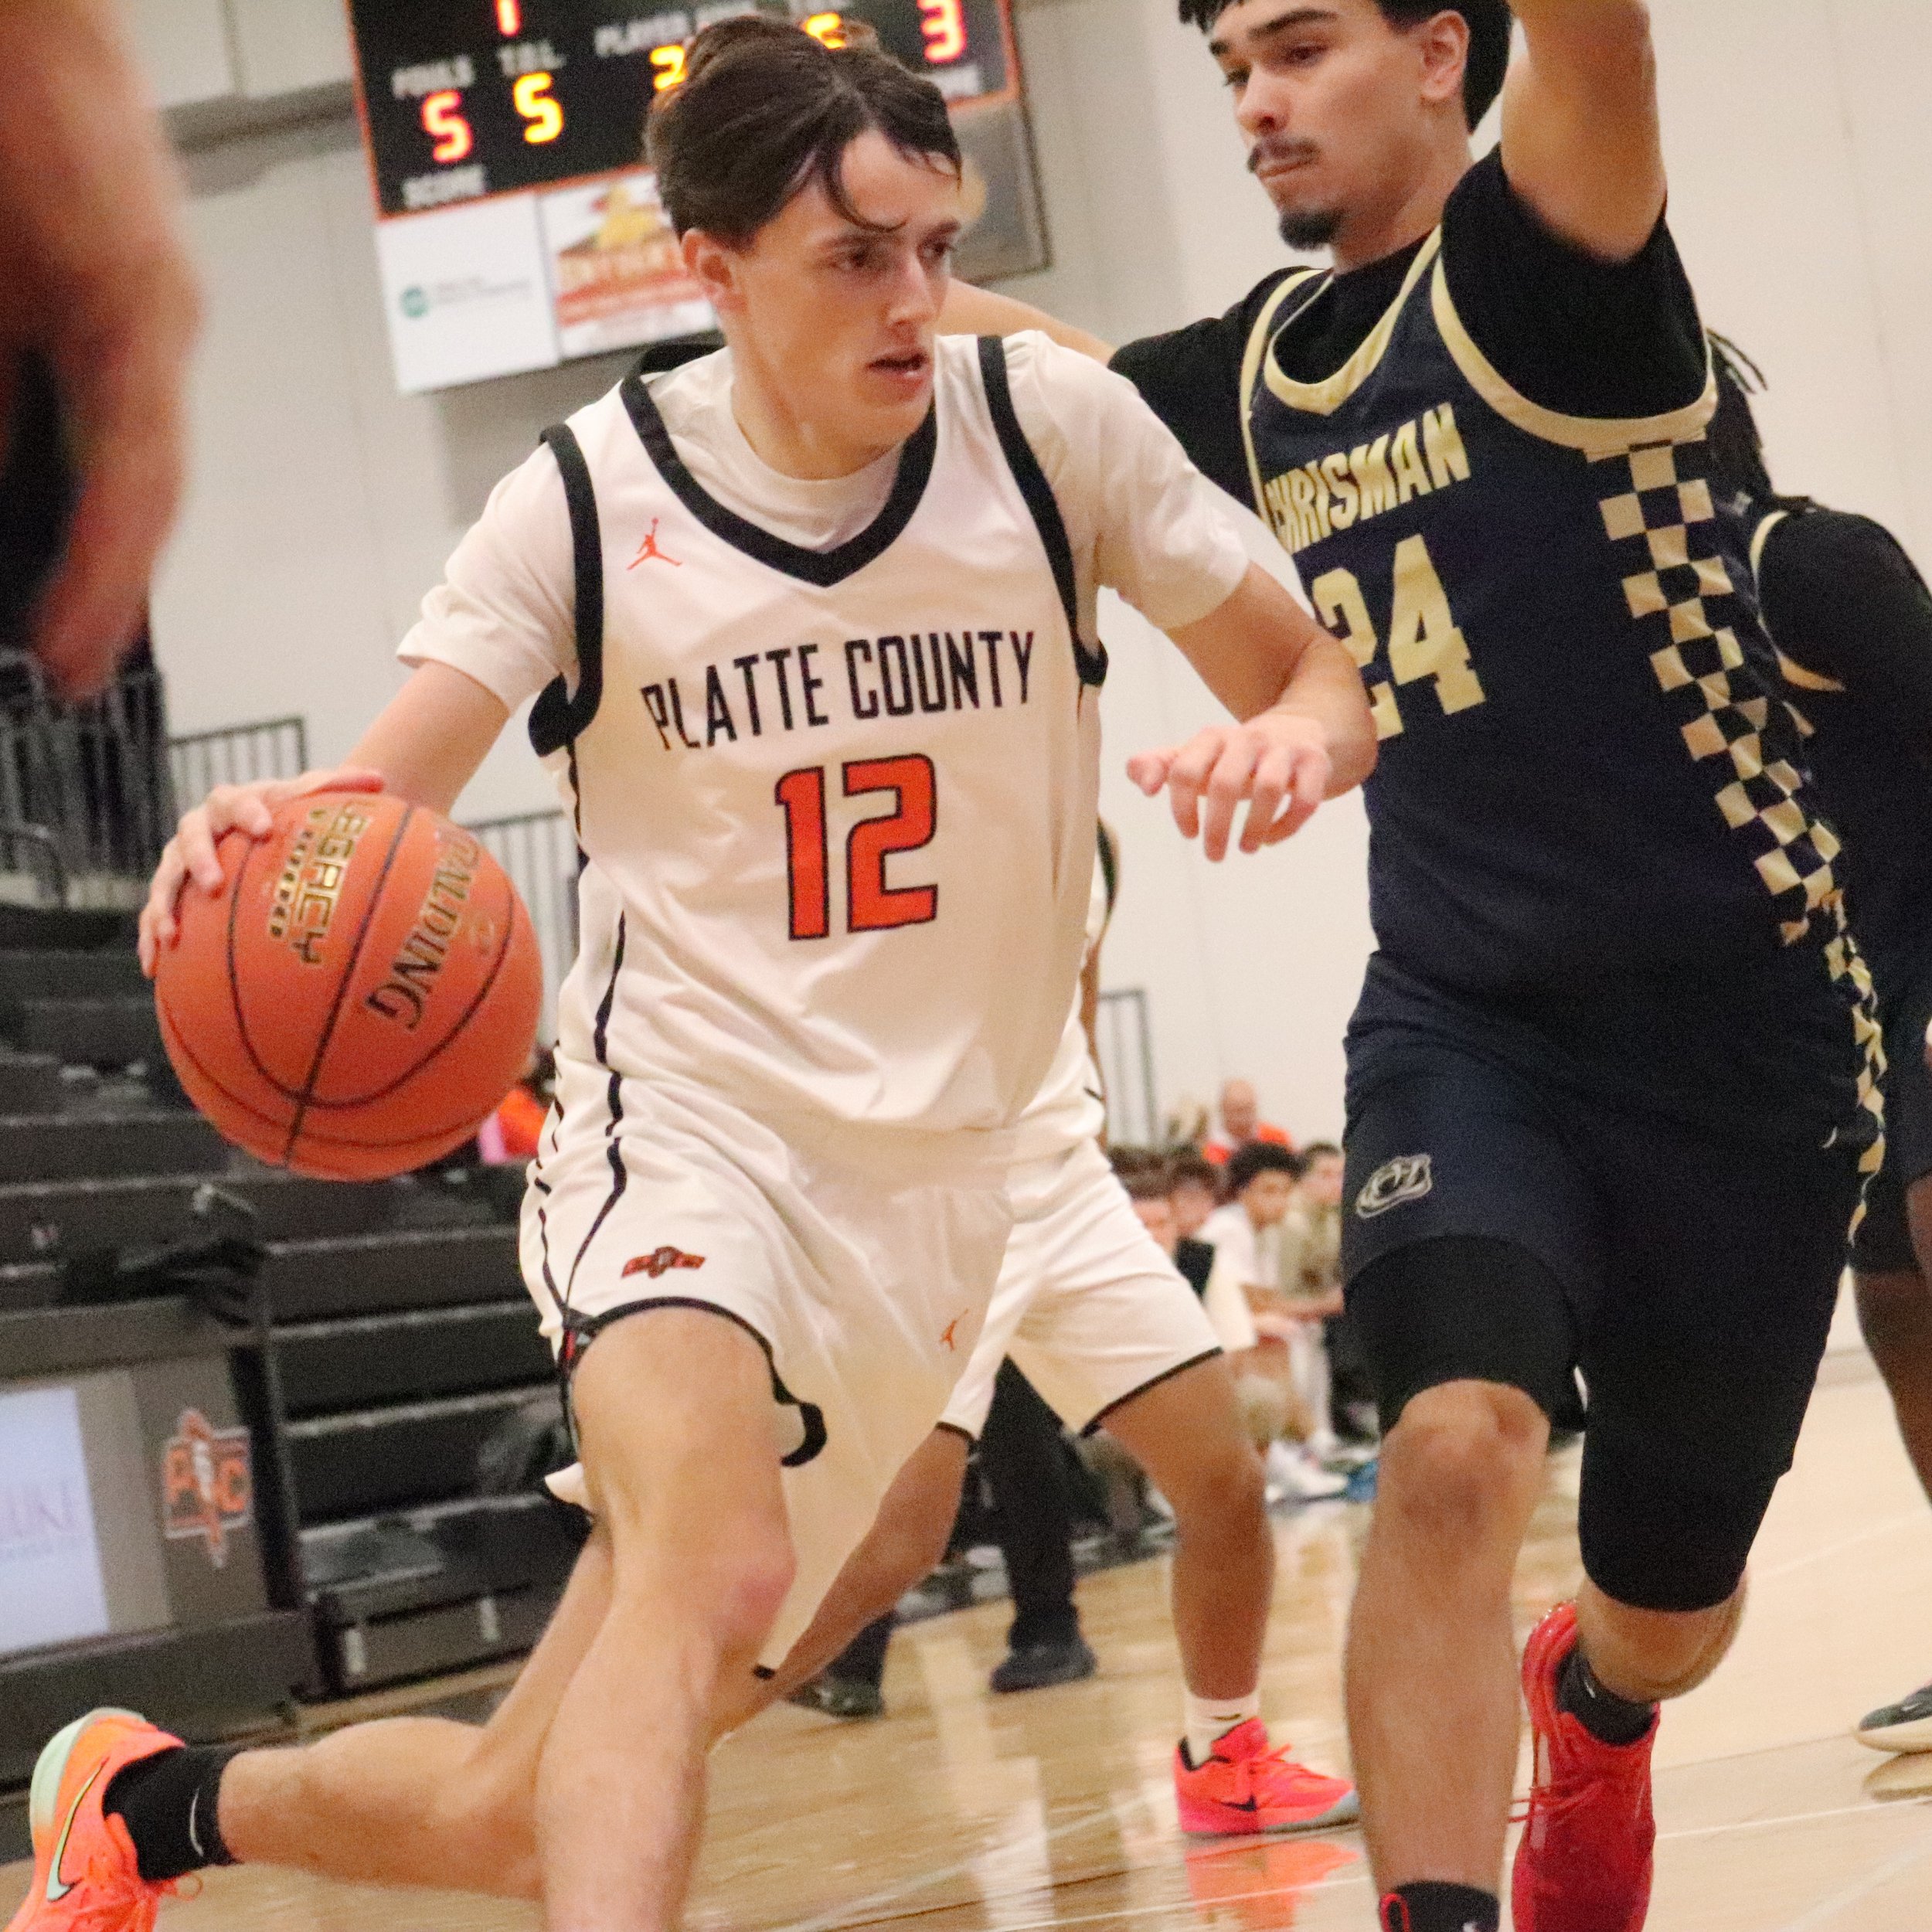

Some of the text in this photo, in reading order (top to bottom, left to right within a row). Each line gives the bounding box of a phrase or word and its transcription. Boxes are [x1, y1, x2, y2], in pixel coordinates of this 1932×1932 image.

[422, 89, 473, 163] 5
[512, 72, 564, 145] 5
[640, 631, 1034, 751] PLATTE COUNTY
[1312, 533, 1486, 741] 24
[774, 753, 938, 940] 12
